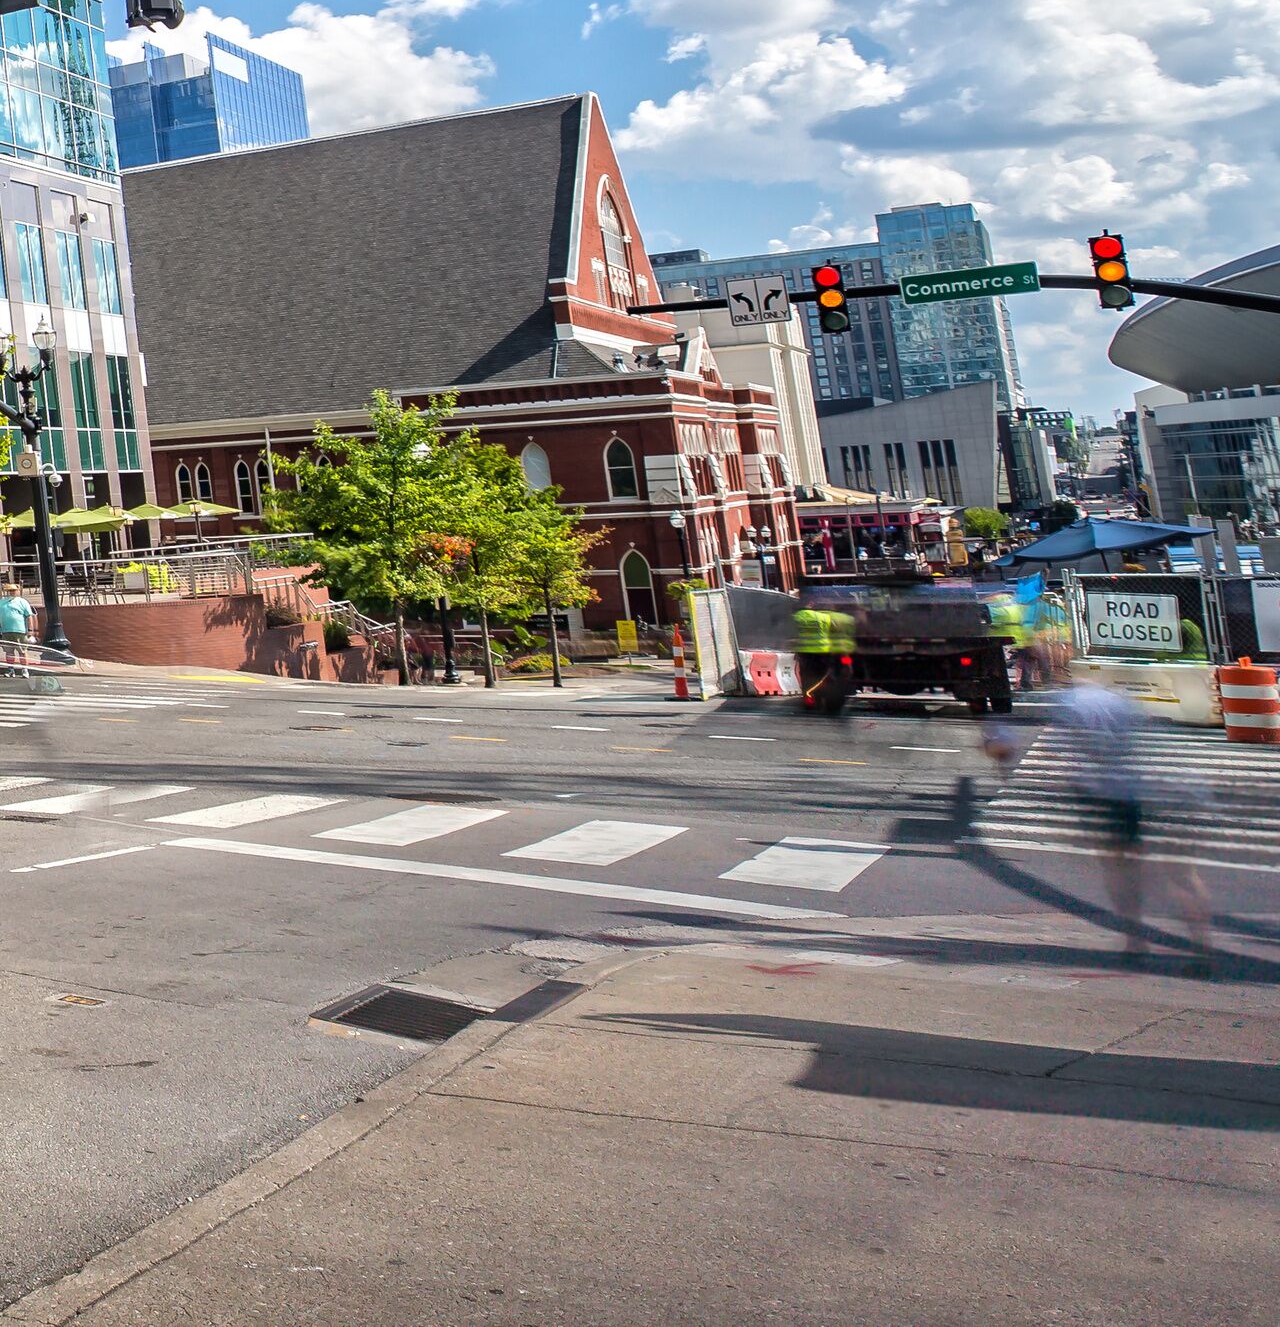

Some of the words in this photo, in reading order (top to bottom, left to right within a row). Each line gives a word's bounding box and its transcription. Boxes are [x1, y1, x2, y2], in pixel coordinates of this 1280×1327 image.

[905, 275, 1014, 297] Commerce
[1022, 274, 1035, 285] St
[734, 313, 758, 322] ONLY
[763, 310, 788, 320] ONLY
[1106, 601, 1159, 619] ROAD
[1097, 622, 1173, 642] CLOSED
